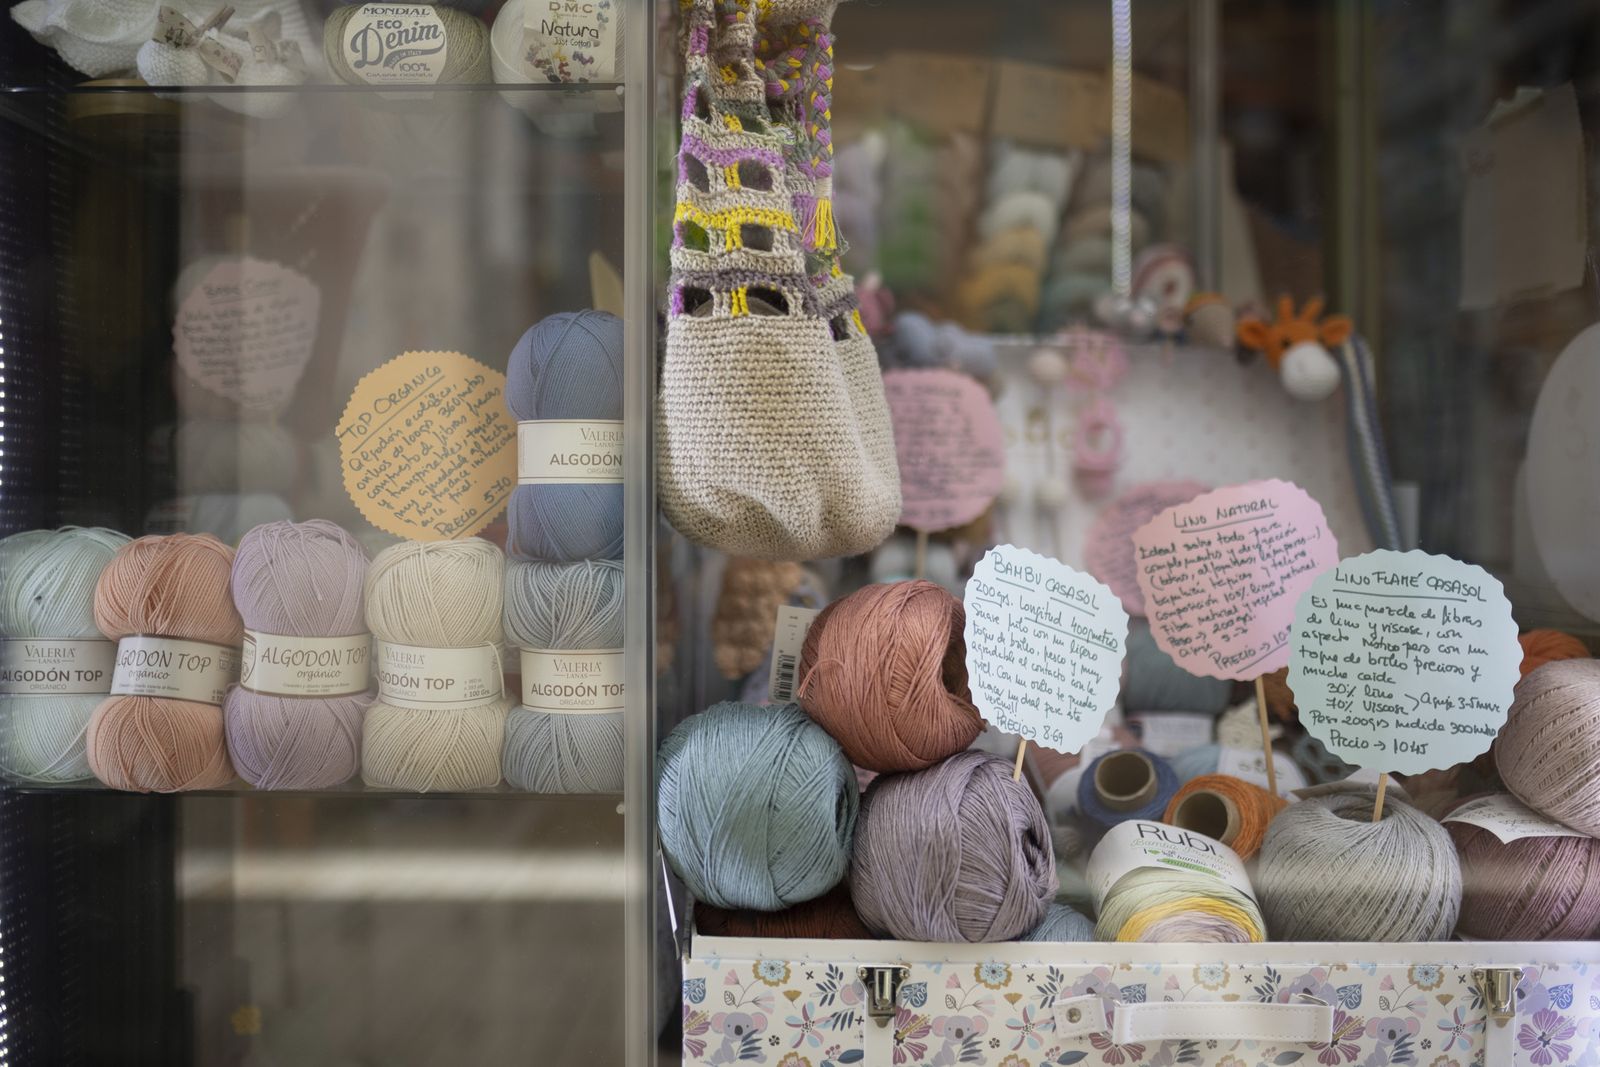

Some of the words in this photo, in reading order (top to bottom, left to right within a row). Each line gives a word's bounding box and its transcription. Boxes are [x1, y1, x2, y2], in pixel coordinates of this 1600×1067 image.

[363, 7, 430, 16] MONDIAL
[376, 19, 402, 30] ECO
[541, 18, 599, 39] Natura
[350, 21, 441, 69] Denim
[570, 38, 592, 48] Cotton
[399, 62, 430, 72] 100%
[339, 411, 372, 439] TOP
[549, 451, 623, 466] ALGODÓN
[1216, 499, 1279, 520] NATURAL
[433, 507, 478, 537] PRECIO
[1183, 537, 1212, 551] sobre
[1217, 531, 1245, 546] todo
[991, 551, 1042, 585] BAMBU
[1045, 578, 1100, 610] CASASOL
[1335, 567, 1371, 586] LINO
[1372, 572, 1423, 588] FLAMÉ
[1426, 576, 1487, 602] CASASOL
[1019, 595, 1062, 627] Longitud
[1311, 595, 1328, 609] Es
[1364, 604, 1416, 619] mezcla
[1420, 608, 1436, 619] de
[1441, 605, 1483, 628] fibras
[971, 602, 1000, 625] Suave
[1033, 629, 1049, 641] con
[1052, 635, 1065, 646] un
[1069, 639, 1098, 661] ligero
[1306, 612, 1322, 624] de
[1329, 611, 1360, 629] lino
[1368, 621, 1378, 641] y
[1436, 629, 1463, 639] con
[24, 644, 76, 659] VALERIA
[972, 620, 994, 642] toque
[996, 631, 1006, 644] de
[1043, 645, 1066, 665] fresco
[1070, 660, 1077, 677] y
[1080, 663, 1103, 684] muy
[1301, 628, 1350, 647] aspecto
[1402, 641, 1431, 659] pero
[1438, 644, 1461, 654] con
[1468, 644, 1489, 656] un
[178, 652, 211, 673] TOP
[261, 646, 342, 667] ALGODON
[346, 646, 368, 665] TOP
[384, 646, 425, 665] VALERIA
[552, 658, 602, 673] VALERIA
[1208, 648, 1257, 671] PRECIO
[1299, 645, 1338, 665] toque
[1343, 652, 1361, 664] de
[1368, 651, 1408, 671] brillo
[1413, 655, 1465, 676] precioso
[1470, 664, 1482, 682] y
[2, 667, 70, 682] ALGODÓN
[75, 670, 103, 682] TOP
[128, 669, 171, 681] orgánico
[296, 669, 342, 681] orgánico
[423, 677, 455, 690] TOP
[1018, 656, 1028, 668] al
[1031, 662, 1066, 683] contacto
[1071, 679, 1084, 691] con
[531, 682, 598, 697] ALGODÓN
[978, 674, 1004, 696] hacer
[1008, 689, 1019, 702] un
[1021, 694, 1041, 711] chal
[1015, 675, 1027, 688] un
[1057, 687, 1065, 701] te
[1068, 693, 1098, 712] puedes
[1327, 682, 1357, 698] 30%
[1364, 684, 1394, 699] lino
[1326, 697, 1354, 713] 70%
[993, 706, 1028, 735] PRECIO
[1309, 709, 1338, 726] Peso
[1329, 729, 1370, 749] Precio
